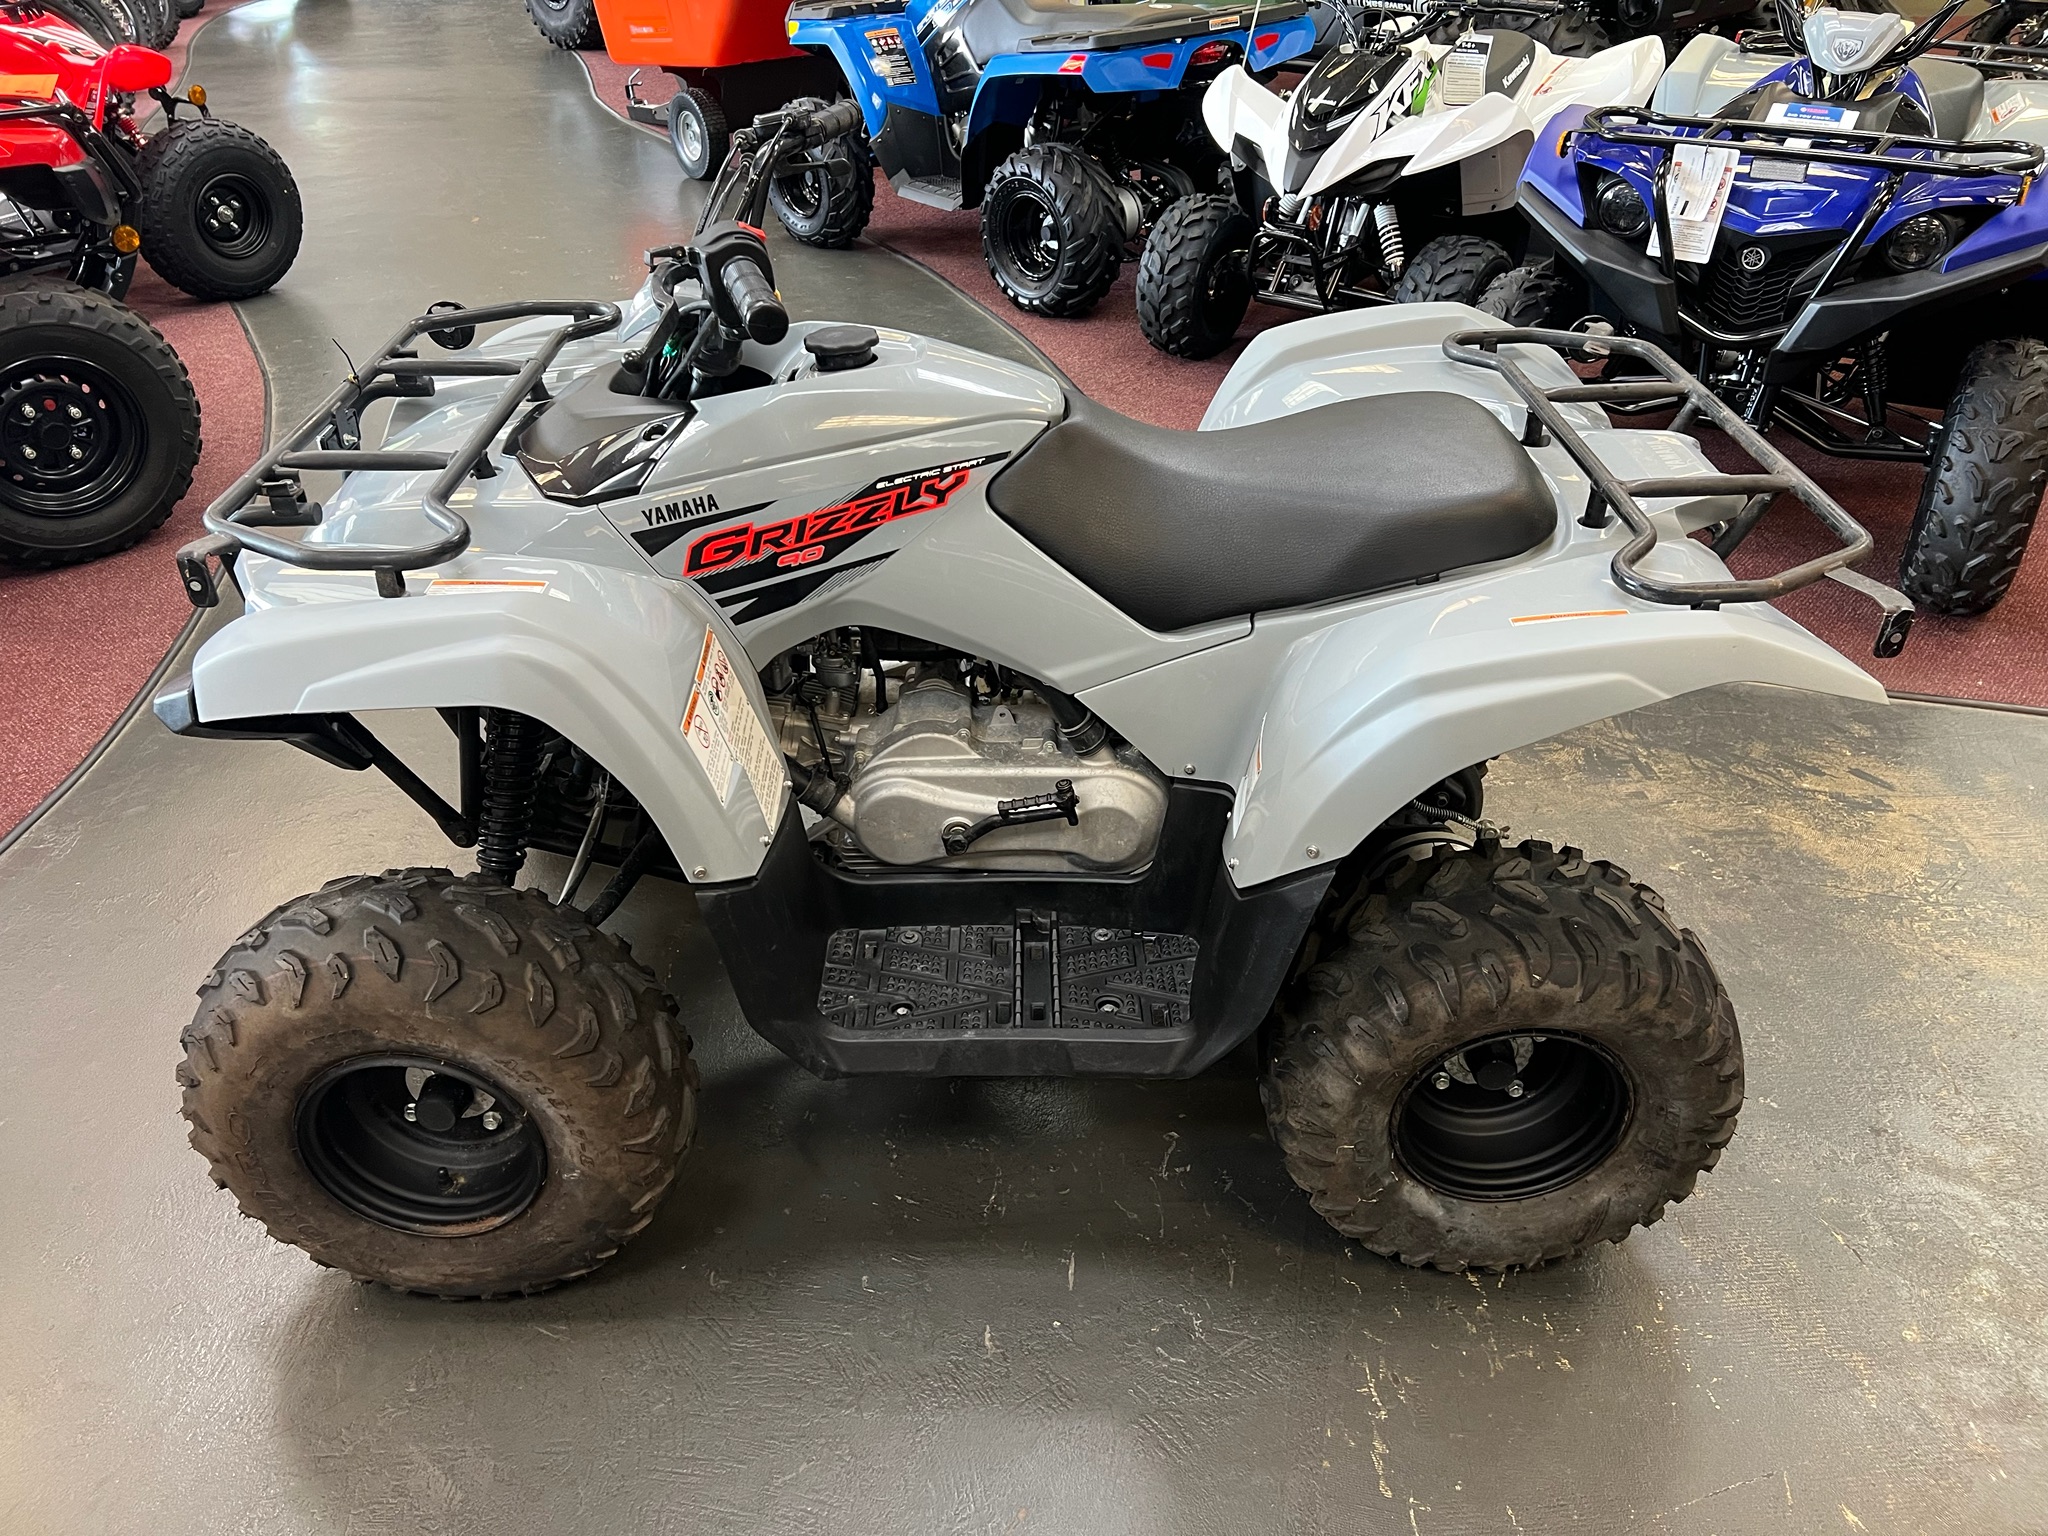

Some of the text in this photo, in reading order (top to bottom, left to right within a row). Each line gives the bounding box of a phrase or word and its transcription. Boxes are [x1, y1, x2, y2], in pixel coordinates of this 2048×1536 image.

[1502, 54, 1530, 88] Kawasaki
[876, 457, 986, 490] ELECTRIC START
[641, 493, 720, 528] YAMAHA
[683, 468, 970, 577] GRIZZLY
[776, 545, 826, 568] 90
